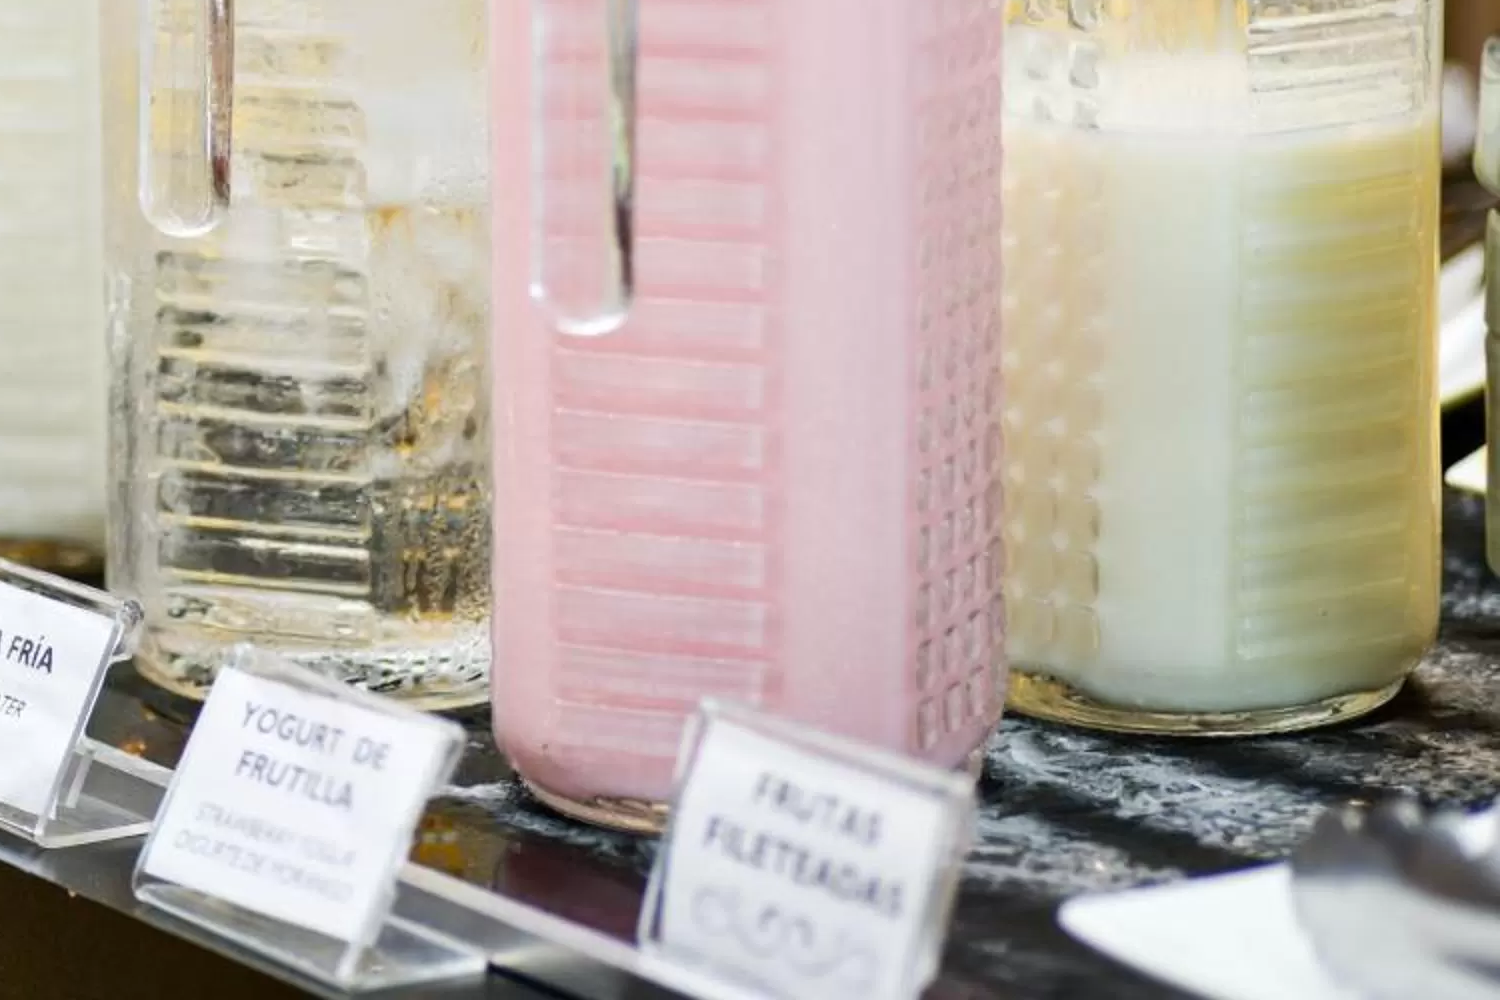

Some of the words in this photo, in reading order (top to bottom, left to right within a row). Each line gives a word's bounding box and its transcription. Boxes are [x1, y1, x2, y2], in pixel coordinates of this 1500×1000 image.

[5, 634, 54, 675] FRÍA
[241, 700, 345, 749] YOGURT
[350, 735, 392, 772] DE
[233, 749, 356, 813] FRUTILLA
[755, 770, 883, 847] FRUTAS
[702, 813, 905, 921] FILETEADAS
